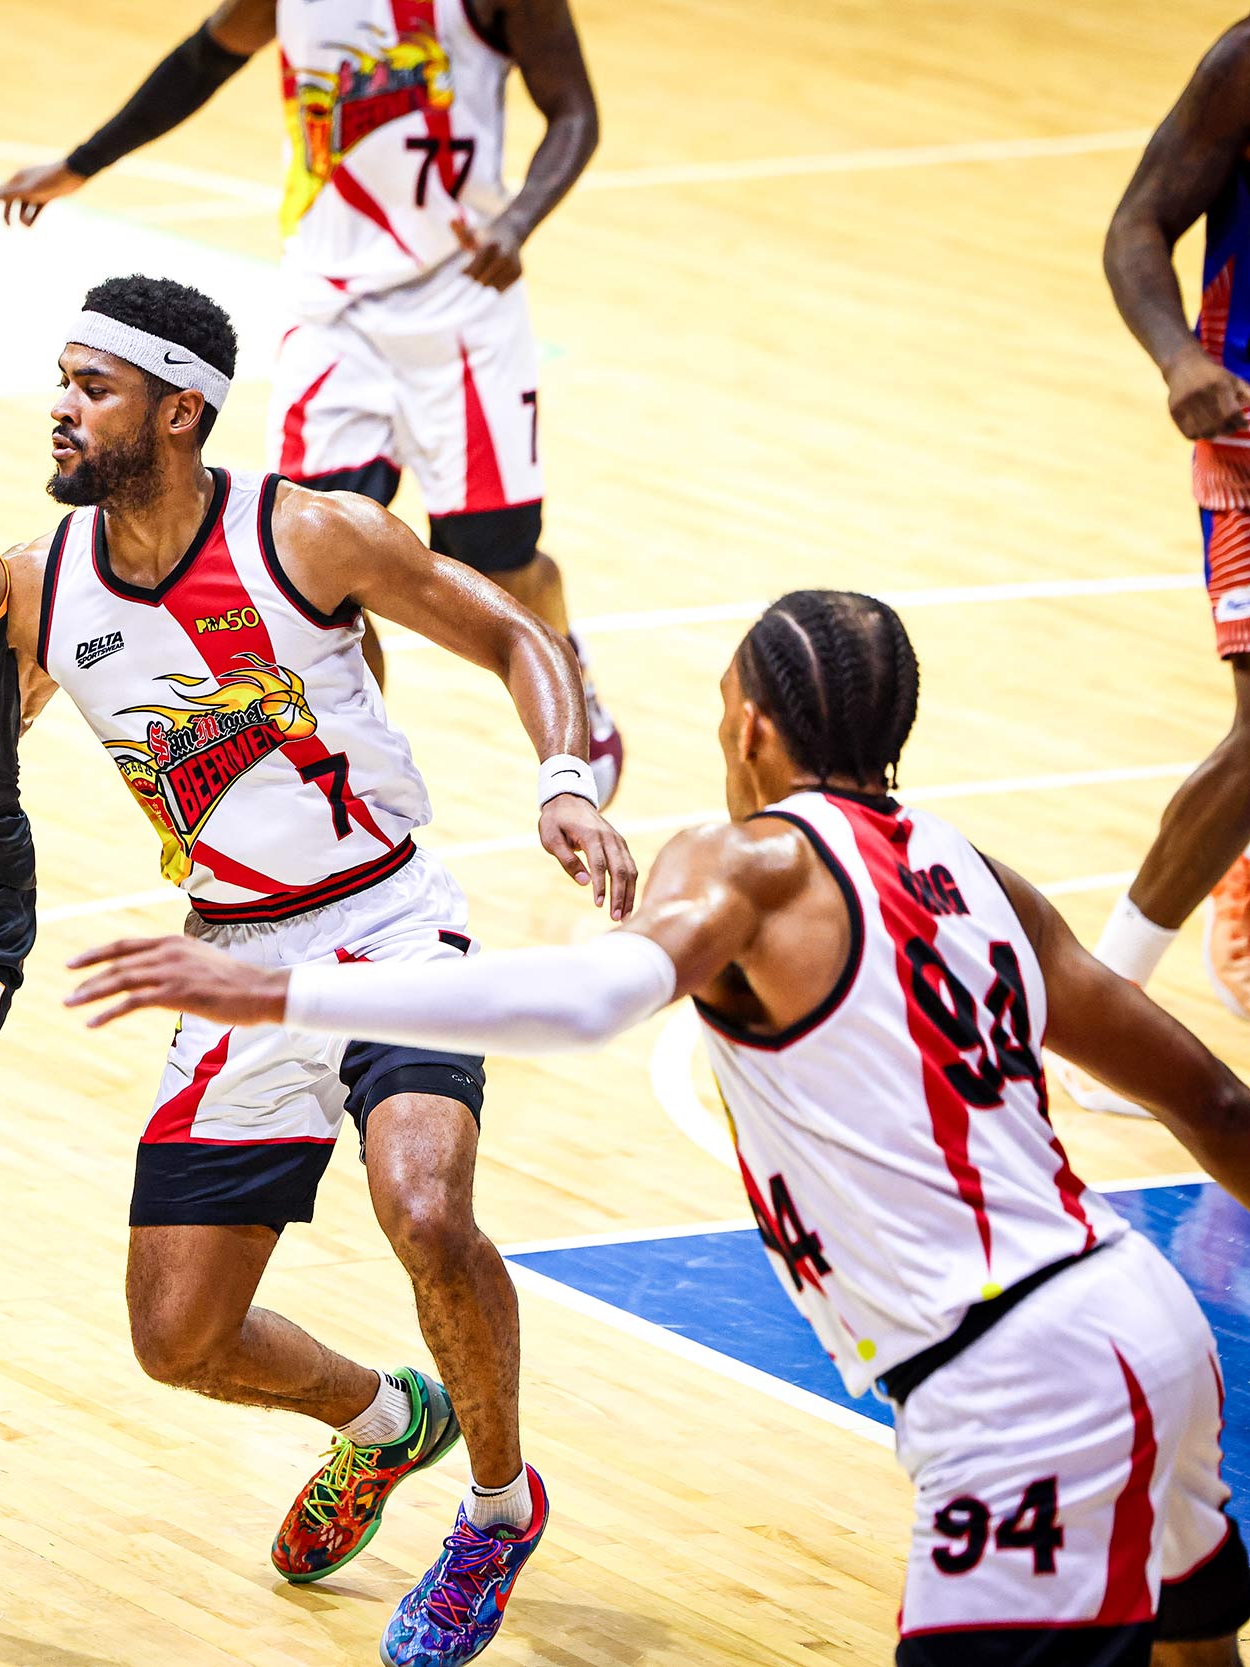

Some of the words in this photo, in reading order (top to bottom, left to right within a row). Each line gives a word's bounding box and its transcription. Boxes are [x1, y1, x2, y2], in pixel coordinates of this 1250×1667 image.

[405, 138, 475, 208] 77
[75, 631, 124, 661] DELTA
[77, 642, 125, 668] SPORTSWEAR
[150, 722, 196, 767] San
[190, 700, 267, 748] Miguel
[169, 720, 286, 828] BEERMEN
[301, 752, 354, 841] 7
[905, 935, 1049, 1120] 94
[931, 1474, 1064, 1577] 94
